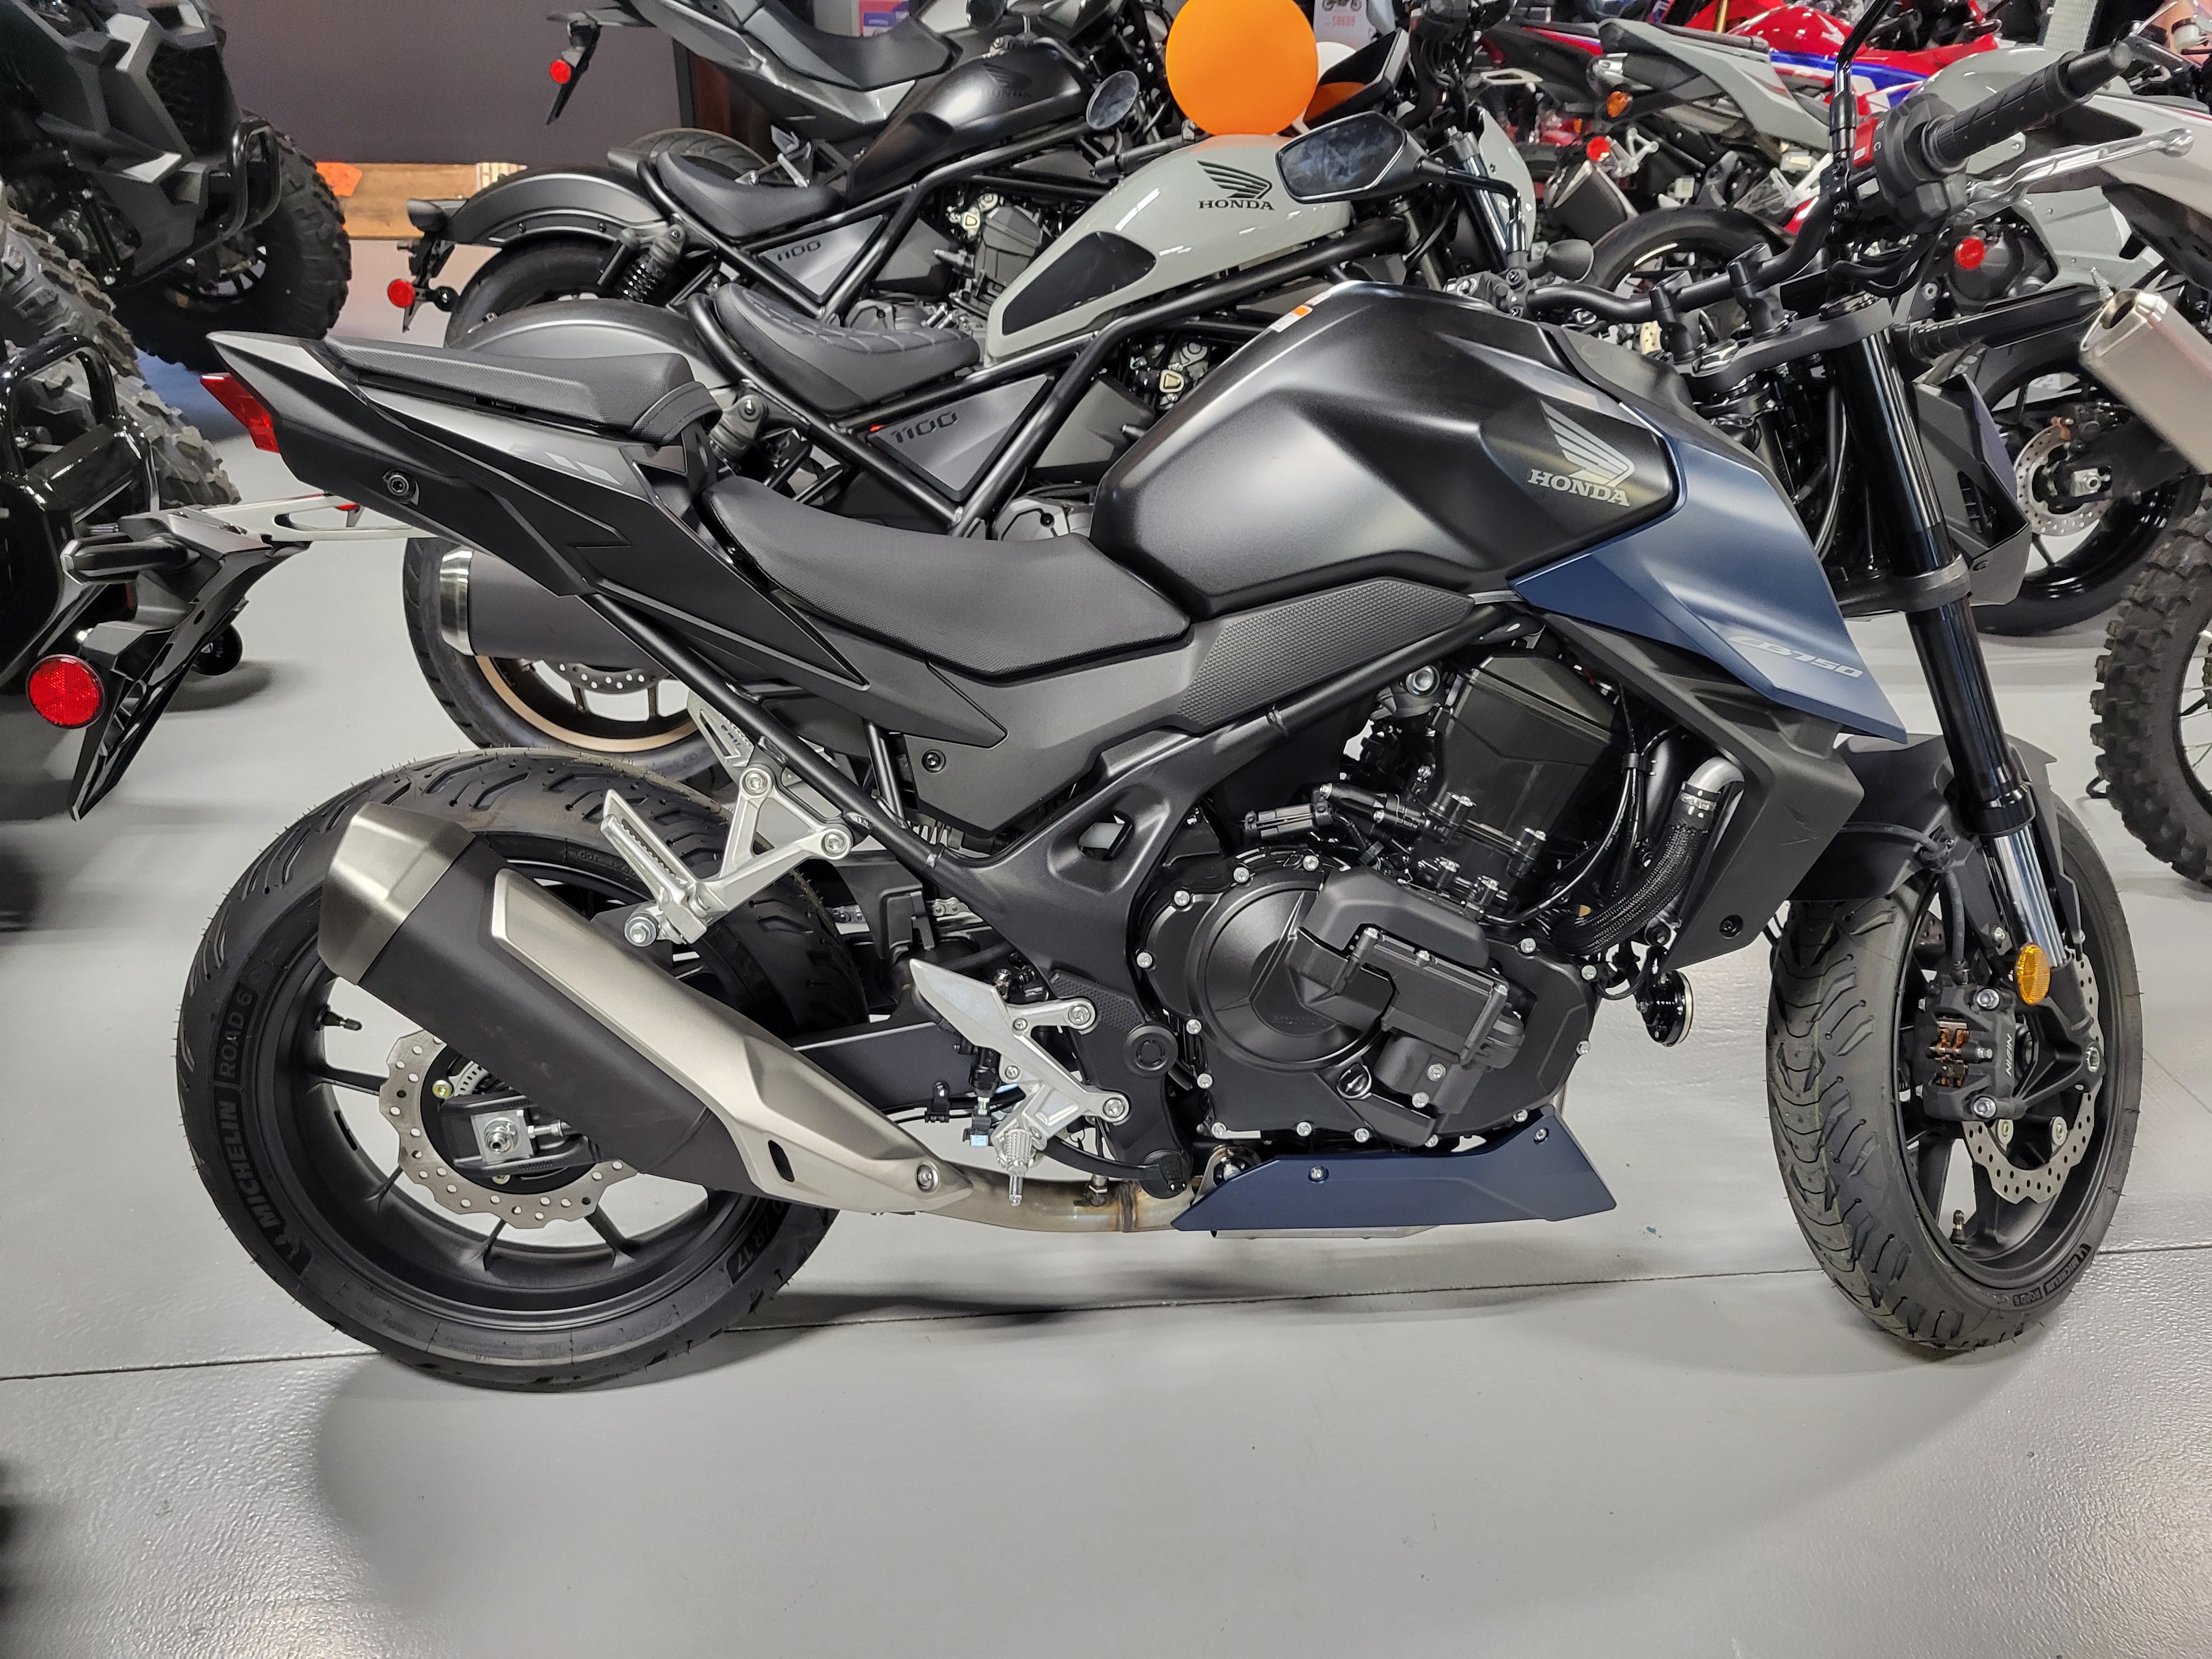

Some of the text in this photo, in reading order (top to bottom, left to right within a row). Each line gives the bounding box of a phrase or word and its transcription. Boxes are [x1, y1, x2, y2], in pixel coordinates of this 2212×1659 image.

[1198, 199, 1276, 211] HONDA
[773, 240, 821, 262] 1100
[890, 411, 958, 444] 1100
[1527, 469, 1631, 507] HONDA
[1728, 635, 1864, 678] CB750
[219, 988, 281, 1229] MICHELIN ROAD 6
[737, 1246, 753, 1273] 17
[2045, 1255, 2080, 1293] MICHELIN
